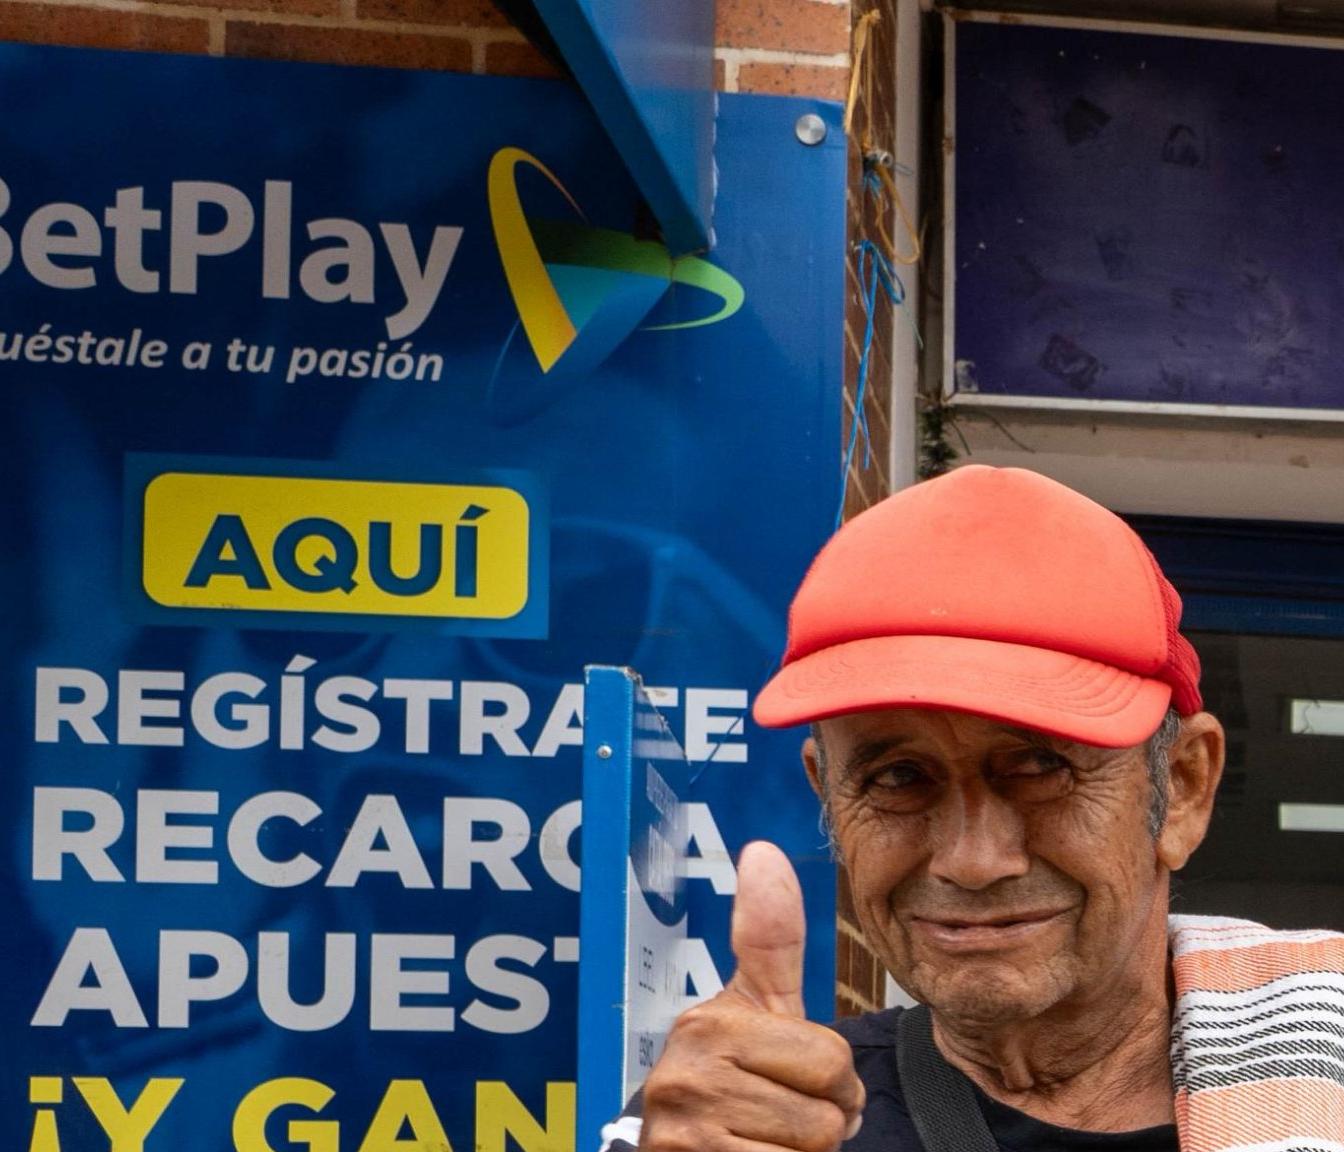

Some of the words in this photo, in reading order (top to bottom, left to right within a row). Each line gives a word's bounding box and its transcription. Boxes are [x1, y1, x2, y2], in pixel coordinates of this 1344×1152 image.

[0, 177, 464, 340] etPlay
[182, 340, 211, 371] a
[226, 337, 274, 374] tu
[287, 338, 444, 384] pasión
[184, 505, 490, 598] AQUÍ
